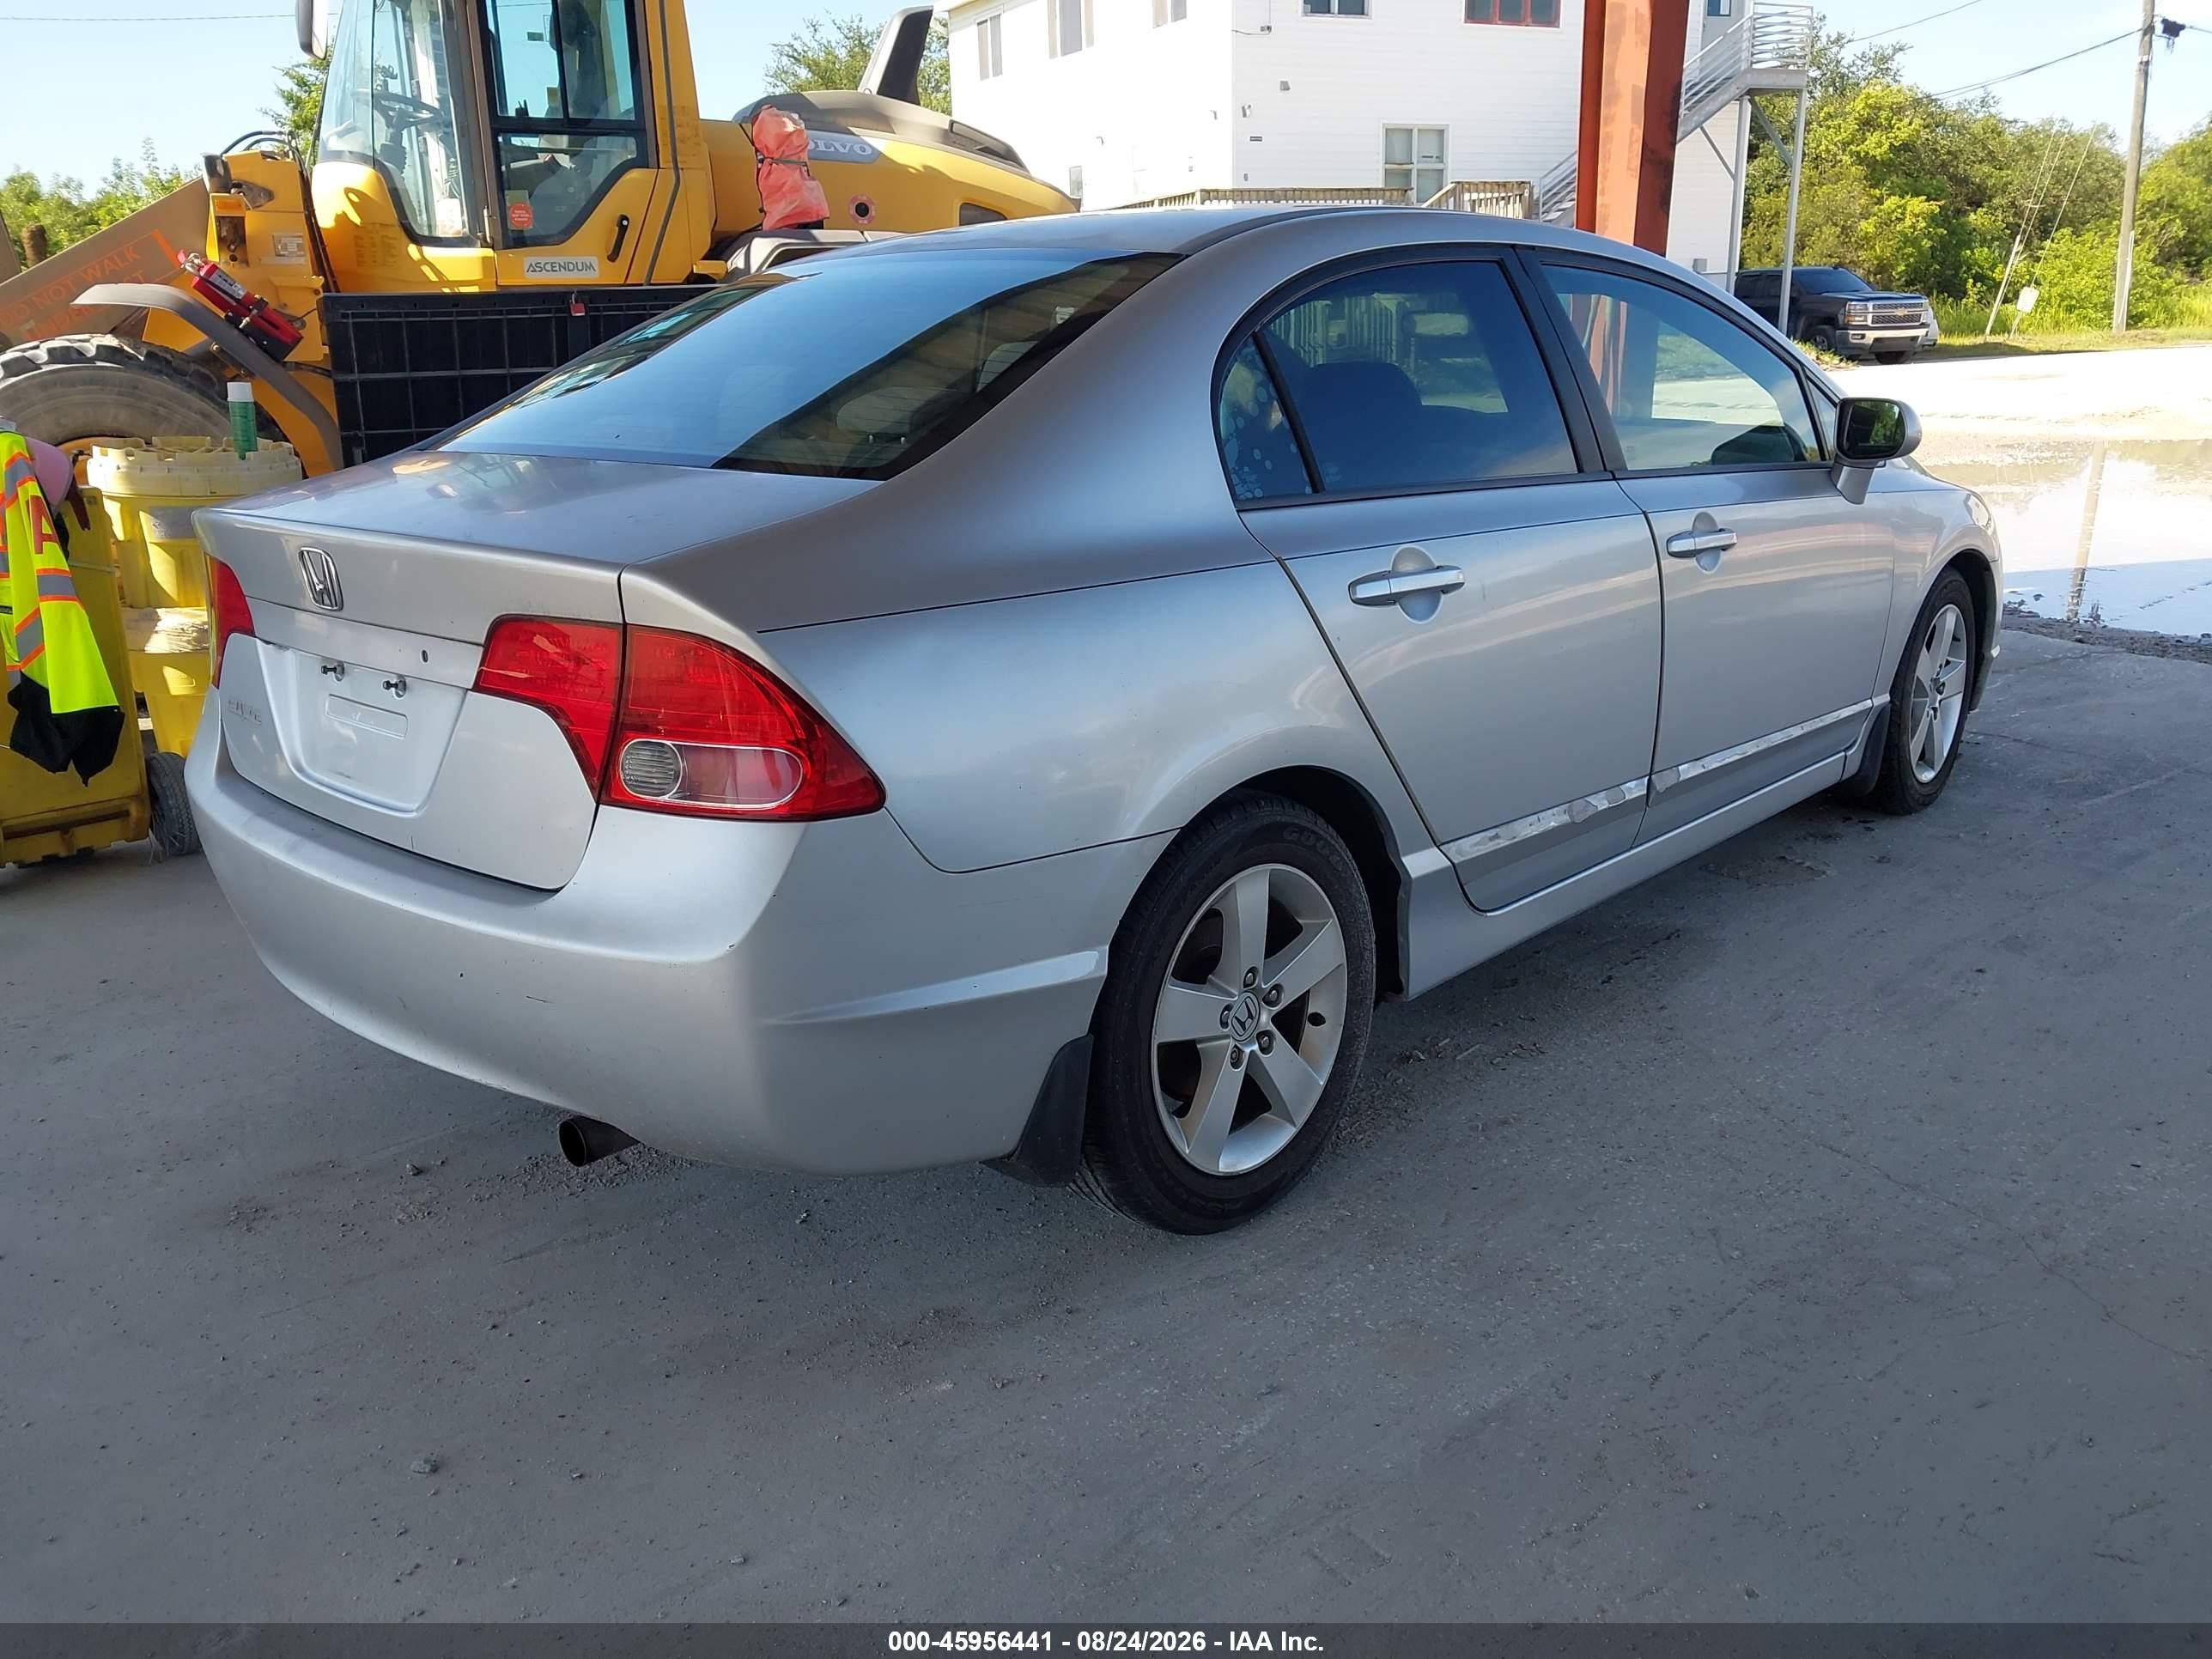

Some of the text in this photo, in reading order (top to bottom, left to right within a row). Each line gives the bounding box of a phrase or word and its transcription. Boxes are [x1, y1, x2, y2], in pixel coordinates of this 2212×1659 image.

[807, 138, 872, 155] LVO
[526, 260, 597, 273] ASCENDUM
[32, 278, 77, 310] NOT
[82, 245, 142, 283] WALK
